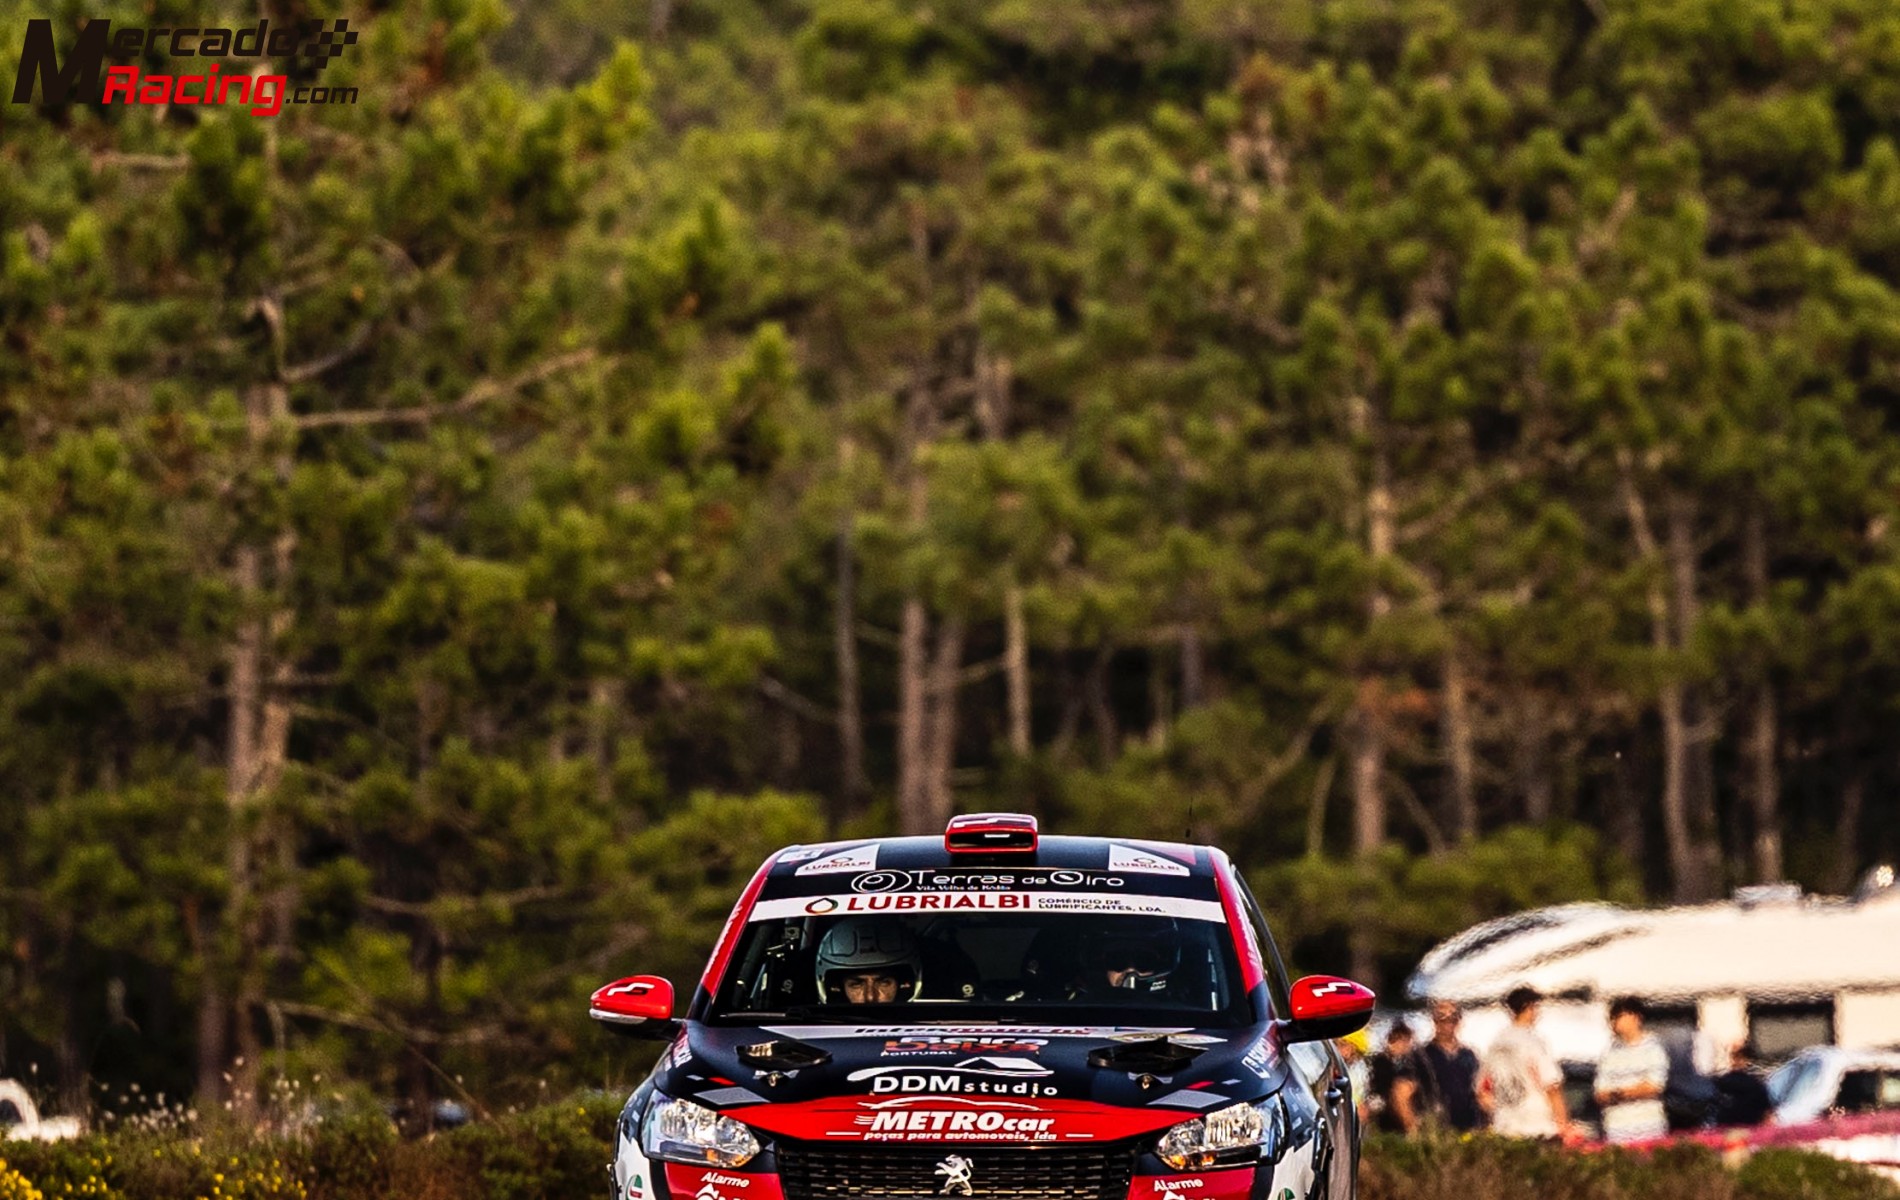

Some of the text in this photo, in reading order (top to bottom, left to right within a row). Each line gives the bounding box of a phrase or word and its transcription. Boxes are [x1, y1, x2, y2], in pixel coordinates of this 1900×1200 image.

[909, 869, 1016, 885] Terras
[847, 894, 1031, 911] LUBRIALBI
[870, 1111, 1054, 1131] METROcar
[907, 1132, 943, 1141] para
